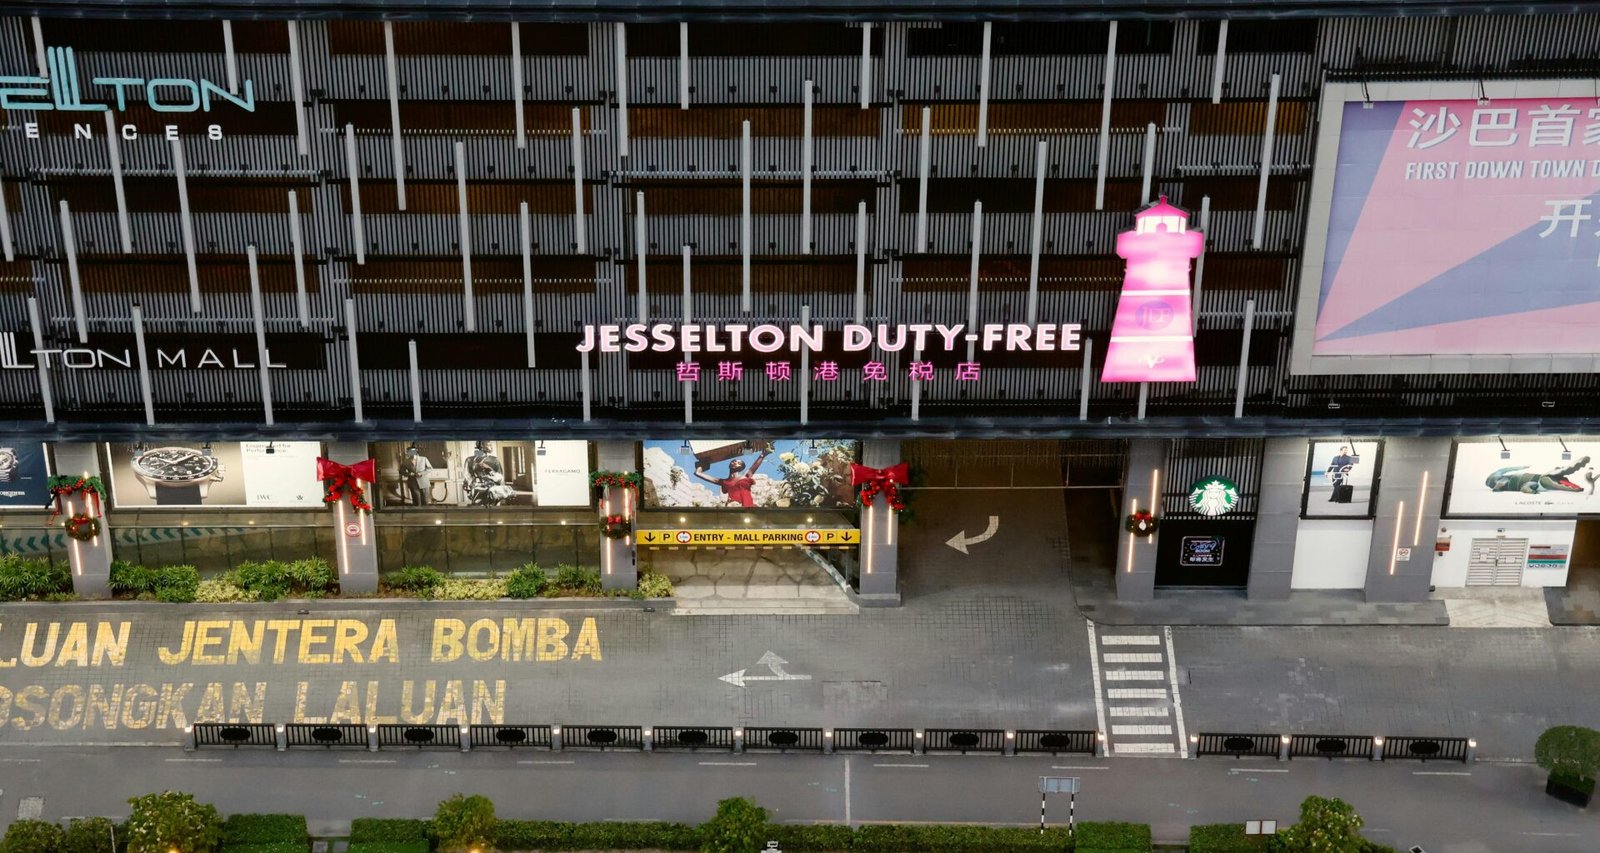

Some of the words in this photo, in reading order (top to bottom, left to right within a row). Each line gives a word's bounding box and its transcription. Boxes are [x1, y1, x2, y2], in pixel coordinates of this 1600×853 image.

[1405, 162, 1458, 180] FIRST
[1464, 161, 1524, 179] DOWN
[1531, 160, 1586, 178] TOWN
[1538, 199, 1600, 239] 开
[576, 324, 824, 354] JESSELTON
[843, 323, 1082, 353] DUTY-FREE
[157, 348, 287, 369] MALL
[676, 360, 982, 382] 哲斯顿港免税店
[663, 533, 671, 541] P
[693, 533, 724, 542] ENTRY
[734, 533, 760, 542] MALL
[762, 533, 804, 542] PARKING
[826, 533, 834, 541] P
[157, 618, 399, 666] JENTERA
[430, 616, 603, 663] BOMBA
[294, 678, 507, 725] LALUAN
